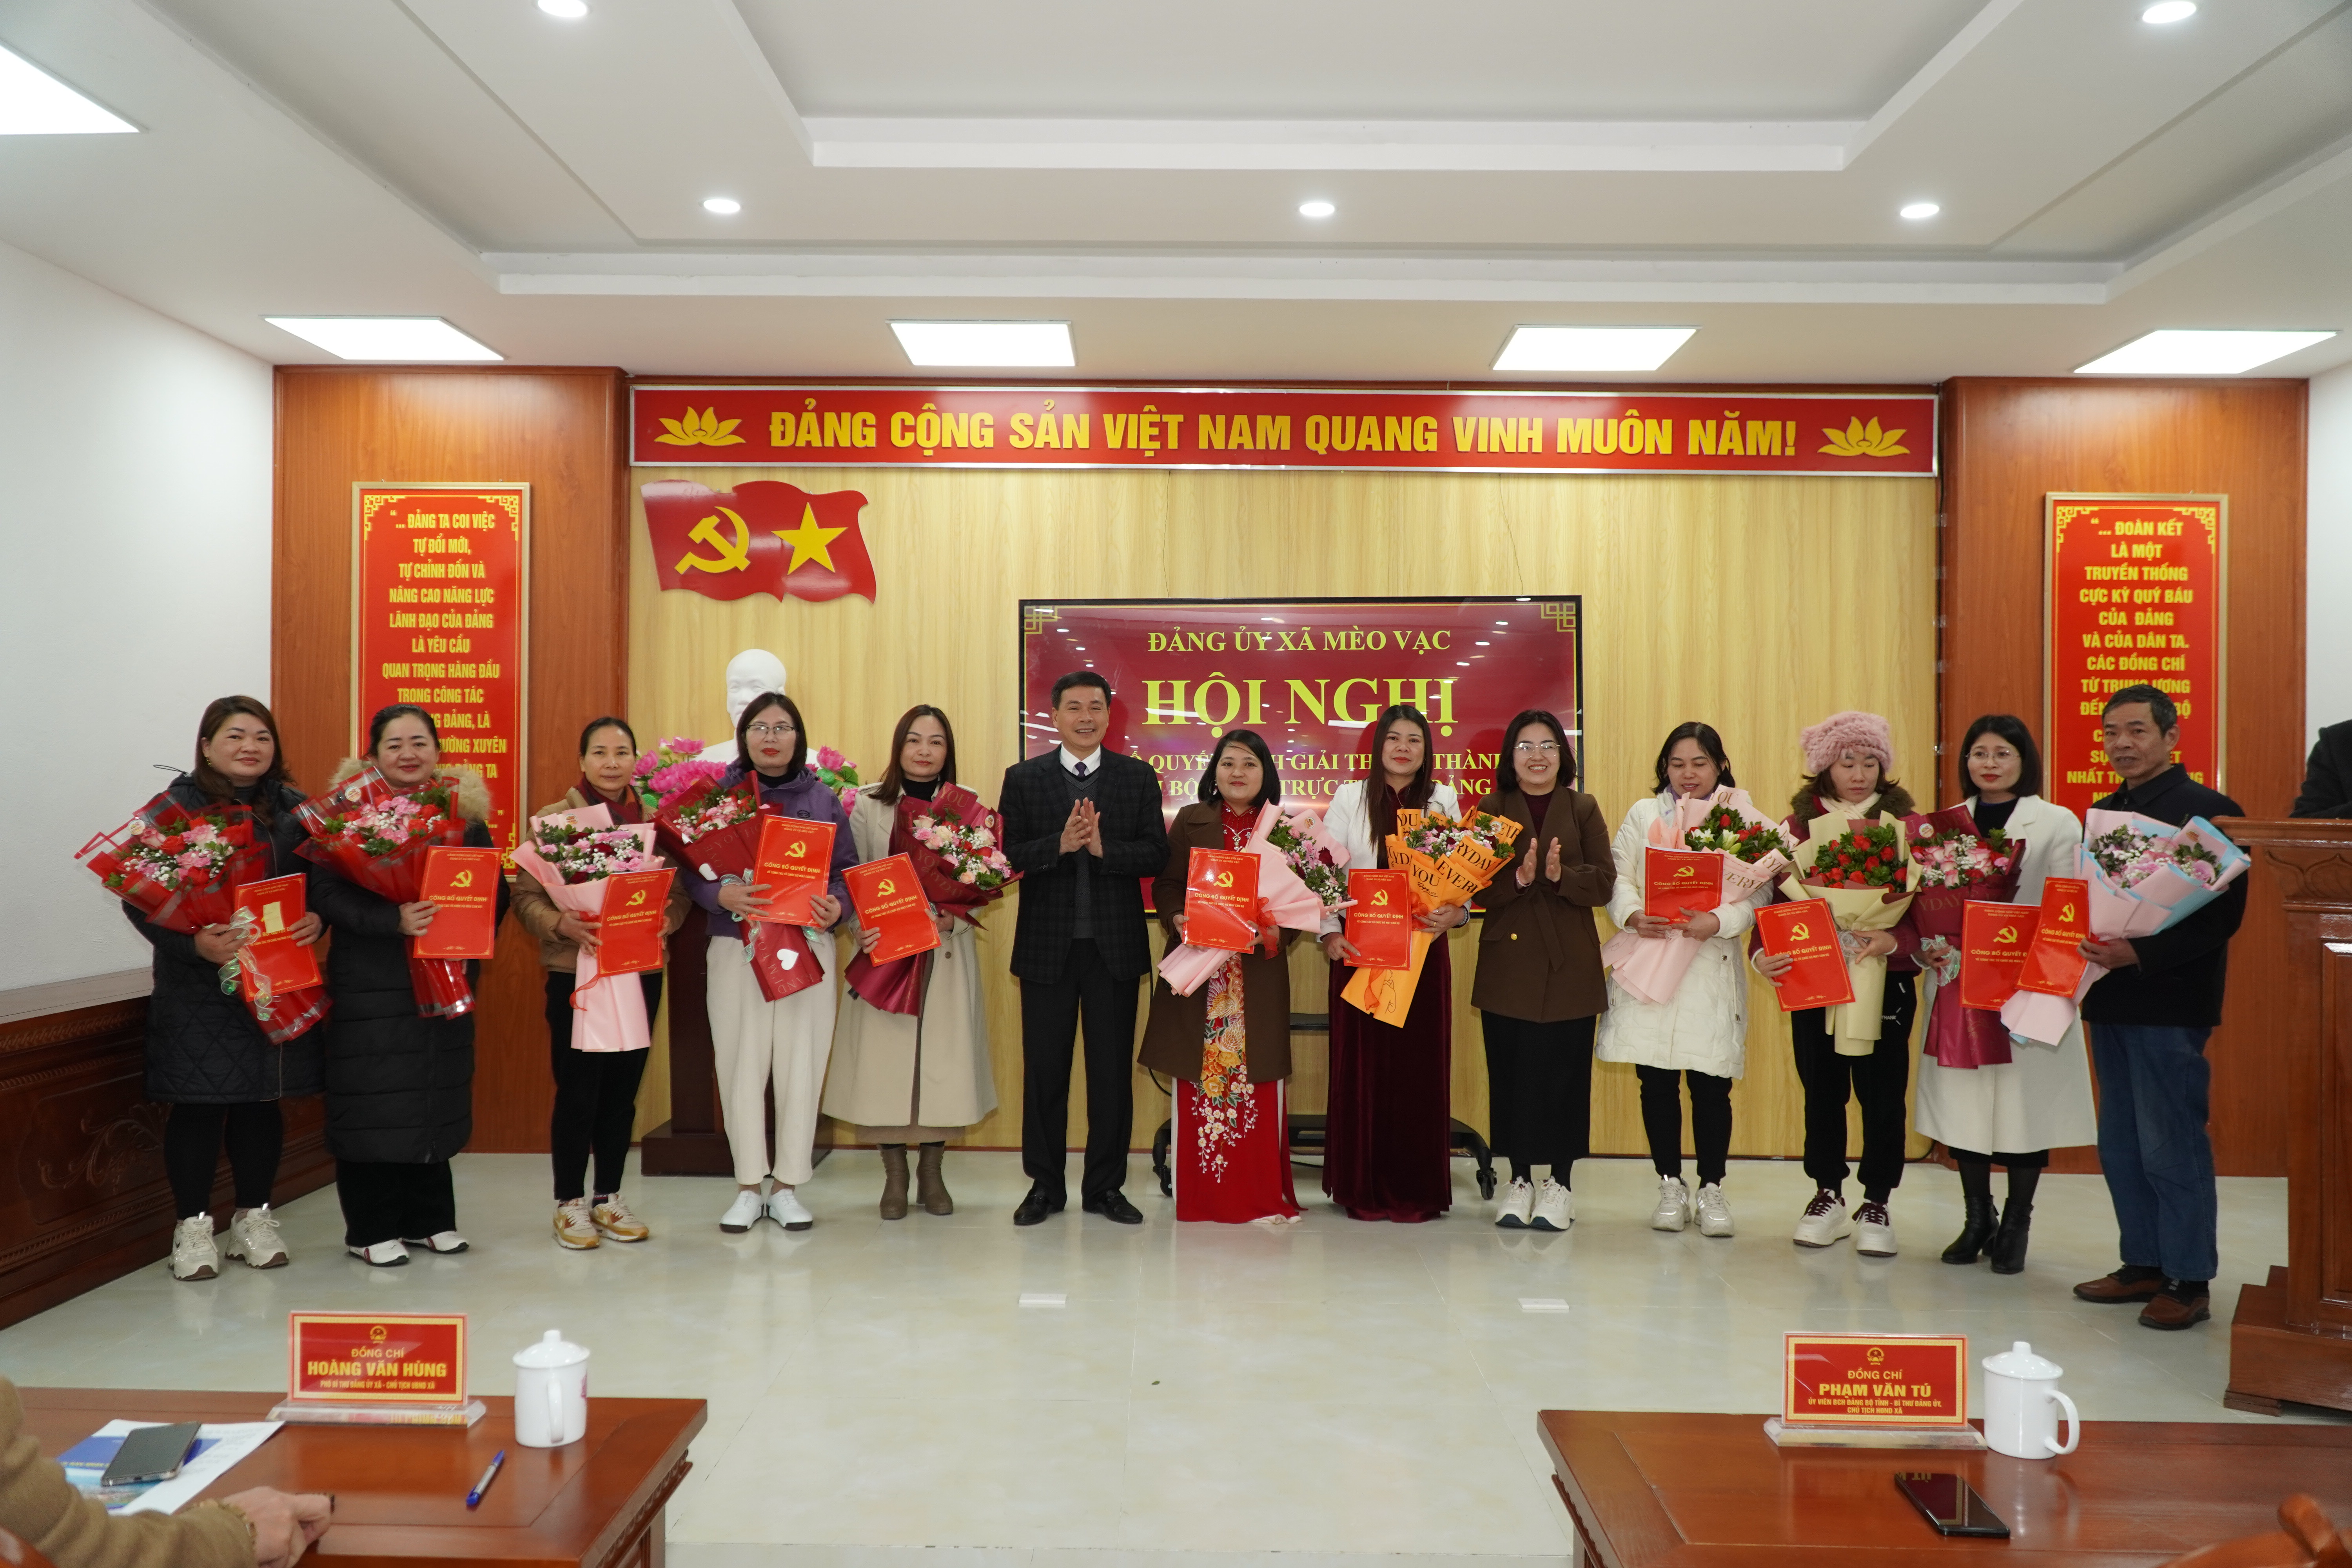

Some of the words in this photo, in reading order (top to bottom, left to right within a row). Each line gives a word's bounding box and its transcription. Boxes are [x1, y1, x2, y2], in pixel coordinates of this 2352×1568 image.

[769, 399, 876, 447] ĐẢNG
[890, 402, 994, 456] CỘNG
[1009, 399, 1090, 449] SẢN
[1103, 405, 1184, 457] VIỆT
[1198, 414, 1291, 450] NAM
[1305, 414, 1438, 455] QUANG
[1453, 416, 1543, 453] VINH
[1557, 408, 1673, 454] MUÔN
[1689, 410, 1796, 456] NĂM!
[407, 509, 436, 528] ĐẢNG
[437, 514, 450, 528] TA
[452, 513, 470, 528] COI
[472, 511, 494, 531] VIỆC
[2115, 519, 2155, 535] ĐOÀN
[2158, 518, 2183, 536] KẾT
[412, 537, 427, 555] TỰ
[427, 534, 446, 553] ĐỔI
[448, 535, 471, 554] MỚI,
[2112, 541, 2129, 558] LÀ
[2132, 541, 2163, 561] MỘT
[398, 562, 412, 581] TỰ
[414, 559, 446, 578] CHỈNH
[447, 559, 469, 578] ĐỐN
[471, 561, 485, 578] VÀ
[2142, 563, 2188, 581] THỐNG
[389, 585, 418, 603] NÂNG
[420, 588, 441, 603] CAO
[443, 586, 472, 603] NĂNG
[474, 588, 494, 606] LỰC
[2080, 588, 2108, 606] CỰC
[2134, 587, 2161, 604] QUÝ
[2165, 587, 2193, 603] BÁU
[389, 610, 416, 628] LÃNH
[418, 613, 439, 631] ĐẠO
[441, 608, 463, 628] CỦA
[465, 609, 493, 628] ĐẢNG
[2099, 607, 2128, 625] CỦA
[2135, 608, 2174, 626] ĐẢNG
[412, 635, 425, 653] LÀ
[427, 635, 446, 653] YÊU
[449, 634, 470, 653] CẦU
[1147, 626, 1226, 652] ĐẢNG
[1234, 625, 1271, 651] ỦY
[1278, 626, 1316, 651] XÃ
[1323, 624, 1387, 651] MÈO
[1393, 630, 1451, 655] VẠC
[2083, 632, 2101, 648] VÀ
[2105, 630, 2133, 648] CỦA
[2137, 632, 2167, 648] DÂN
[2170, 634, 2189, 648] TA.
[382, 663, 410, 679] QUAN
[411, 663, 446, 681] TRỌNG
[448, 661, 476, 678] HÀNG
[478, 659, 499, 679] ĐẦU
[2087, 654, 2116, 670] CÁC
[2162, 655, 2185, 671] CHÍ
[397, 688, 431, 703] TRONG
[433, 686, 461, 703] CÔNG
[464, 686, 483, 703] TÁC
[1142, 671, 1267, 738] HỘI
[1284, 678, 1459, 737] NGHỊ
[443, 709, 475, 729] ĐẢNG,
[477, 711, 490, 728] LÀ
[473, 735, 507, 753] XUYÊN
[485, 764, 497, 778] TA
[1149, 750, 1212, 773] QUYẾ
[1291, 750, 1339, 770] GIẢI
[1344, 753, 1372, 770] TH
[2067, 766, 2104, 784] NHẤT
[939, 784, 970, 808] YOU
[1170, 778, 1198, 800] BỘ
[1279, 777, 1338, 799] TRỰC
[1413, 864, 1441, 886] YOU
[889, 898, 904, 906] QUYẾT
[351, 1346, 382, 1357] ĐỒNG
[385, 1347, 404, 1358] CHÍ
[366, 1360, 398, 1376] VĂN
[1847, 1367, 1880, 1379] ĐỒNG
[1883, 1369, 1903, 1379] CHÍ
[1819, 1383, 1867, 1398] PHẠM
[1873, 1382, 1906, 1397] VĂN
[1911, 1383, 1931, 1397] TÚ
